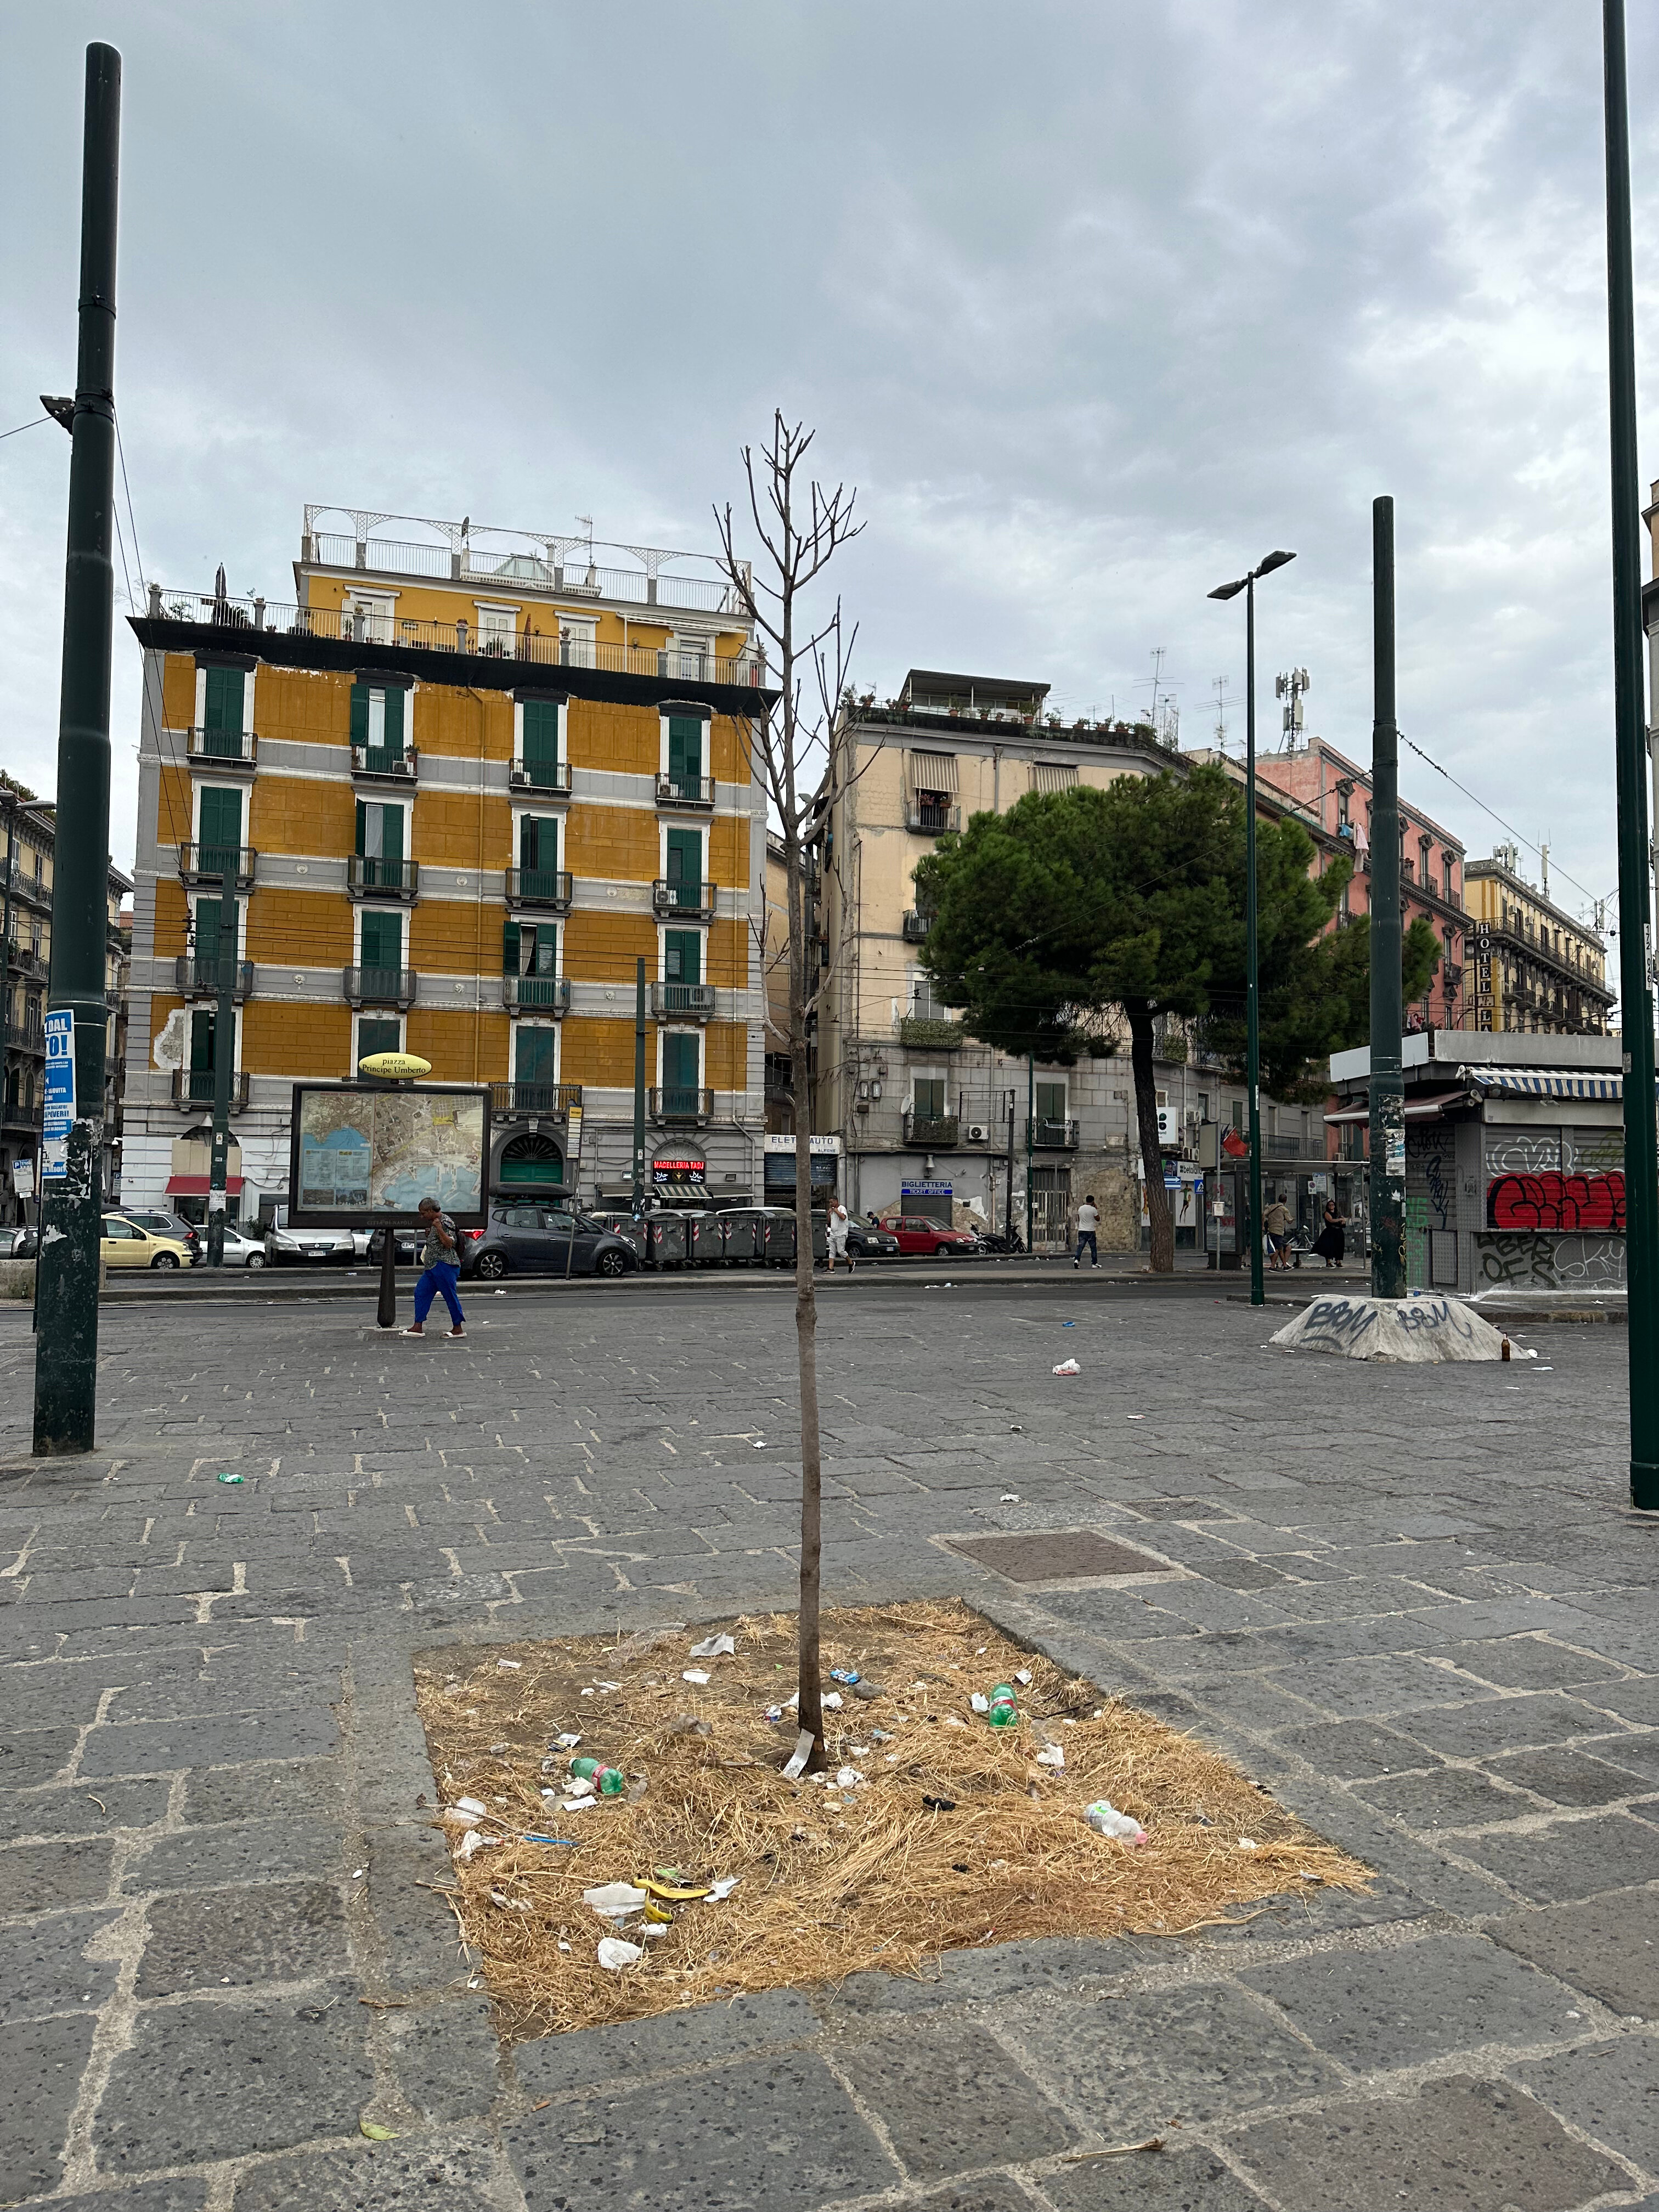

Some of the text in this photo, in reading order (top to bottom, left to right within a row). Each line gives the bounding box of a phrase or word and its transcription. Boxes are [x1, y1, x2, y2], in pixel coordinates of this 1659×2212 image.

[1480, 923, 1491, 992] HOTEL
[48, 1018, 67, 1032] DAL
[362, 1064, 392, 1074] Principe
[654, 1161, 689, 1169] MACELLERIA
